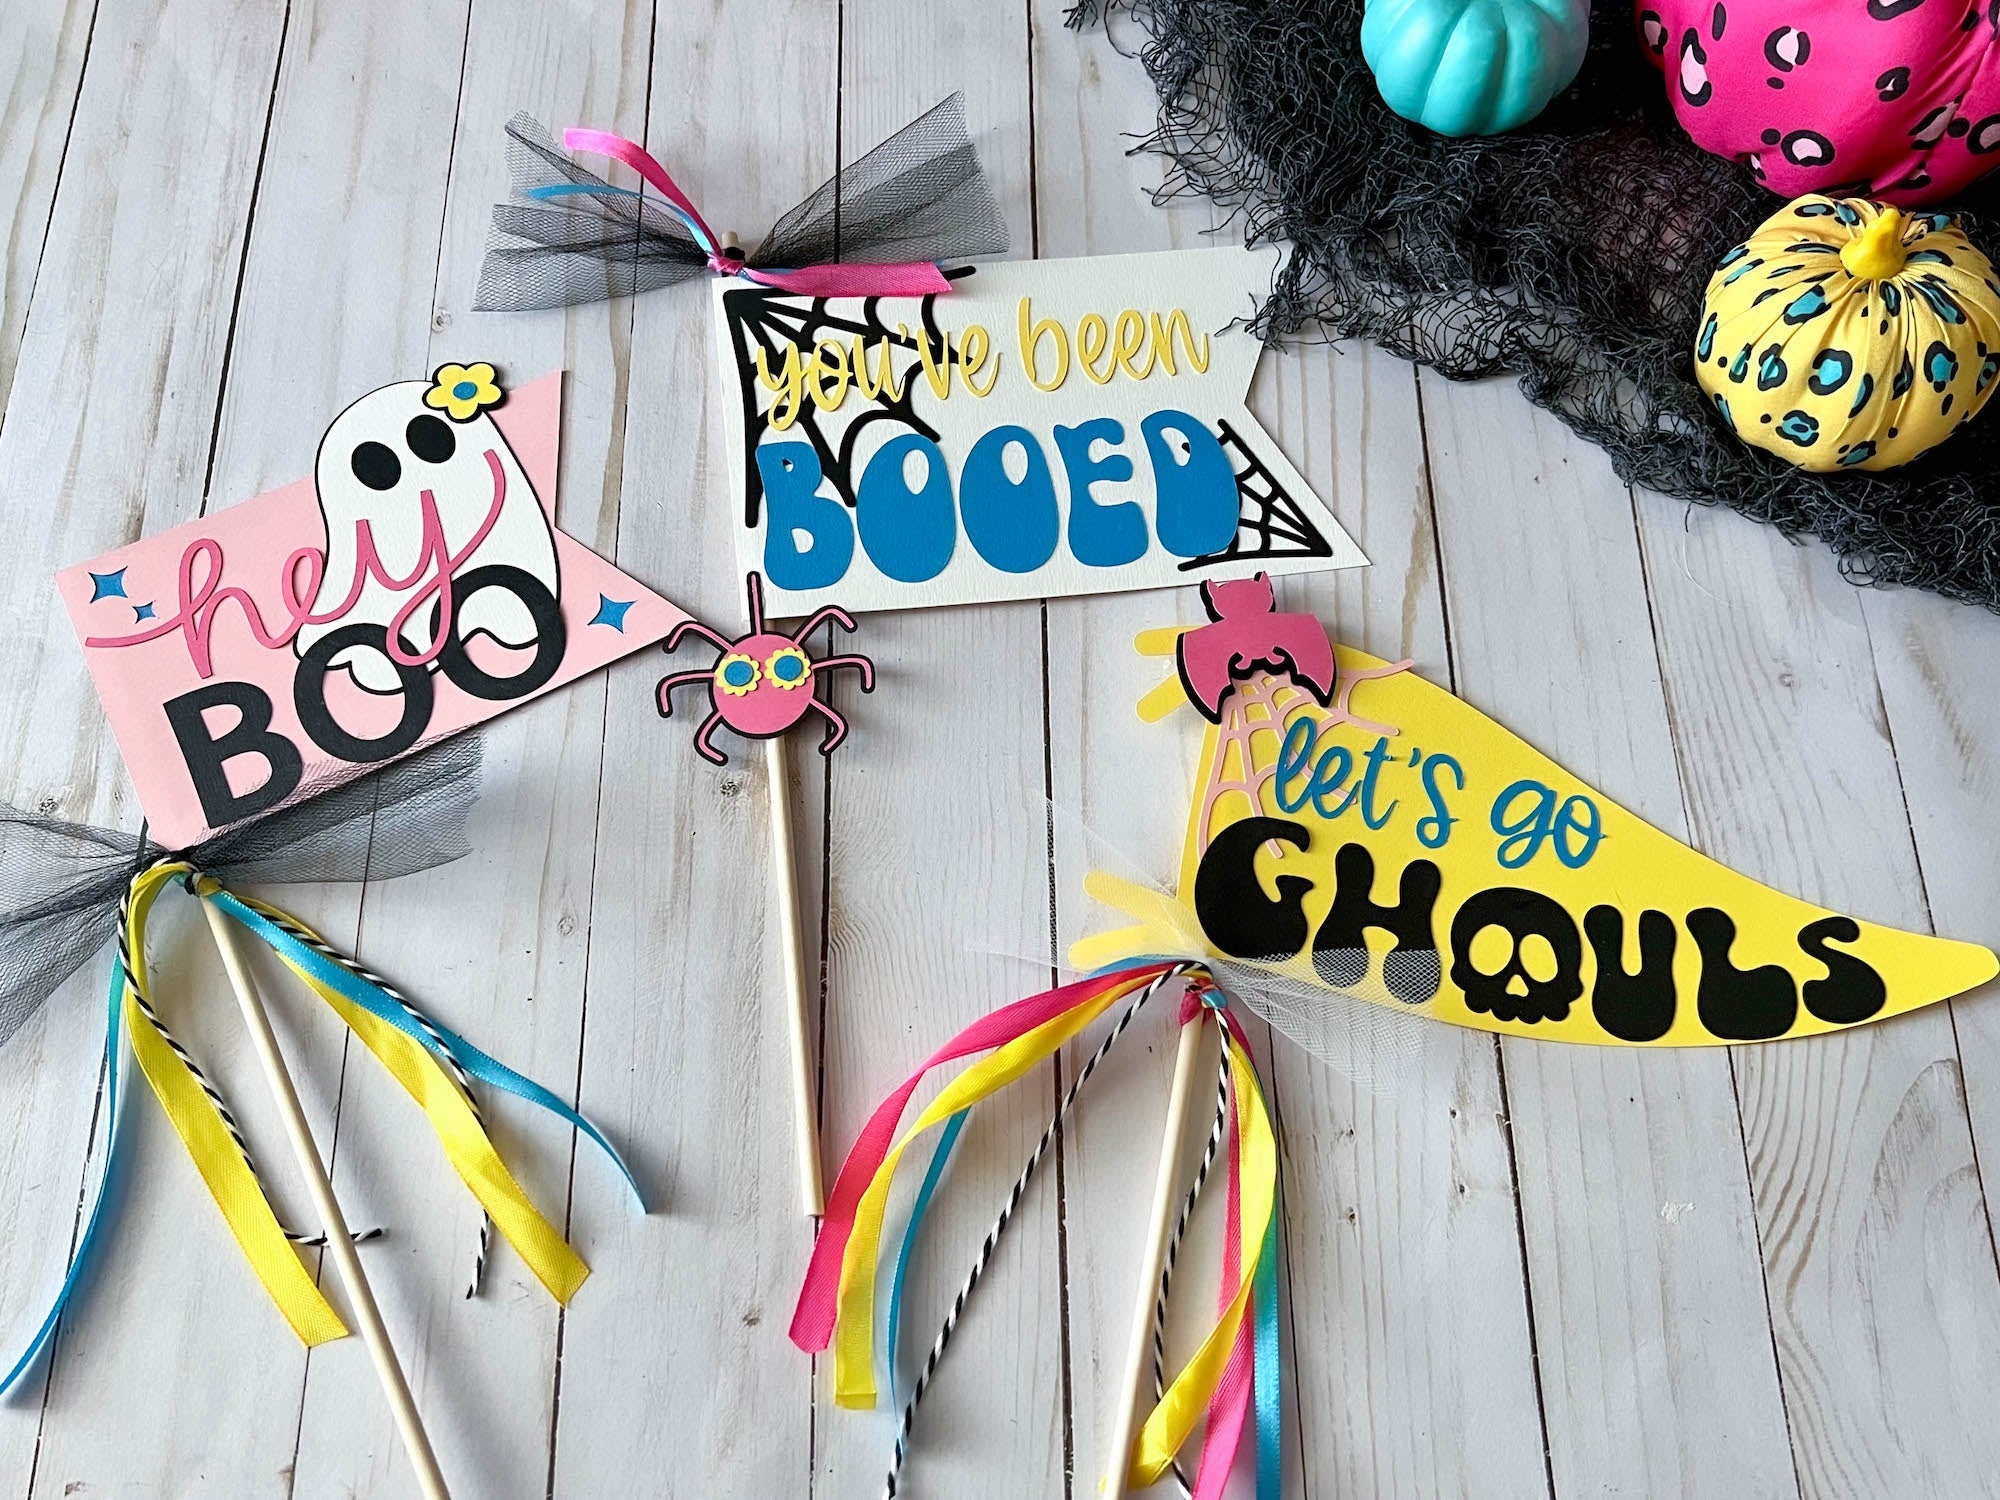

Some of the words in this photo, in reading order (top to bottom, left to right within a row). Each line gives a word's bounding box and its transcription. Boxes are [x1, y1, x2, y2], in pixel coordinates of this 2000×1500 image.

[757, 321, 1001, 431] you've
[1018, 296, 1209, 392] been
[85, 449, 505, 679] hey
[756, 408, 1242, 590] BOOED
[163, 564, 566, 829] BOO
[1274, 716, 1464, 849] let's
[1490, 779, 1606, 869] go
[1194, 816, 1887, 1042] GHOULS
